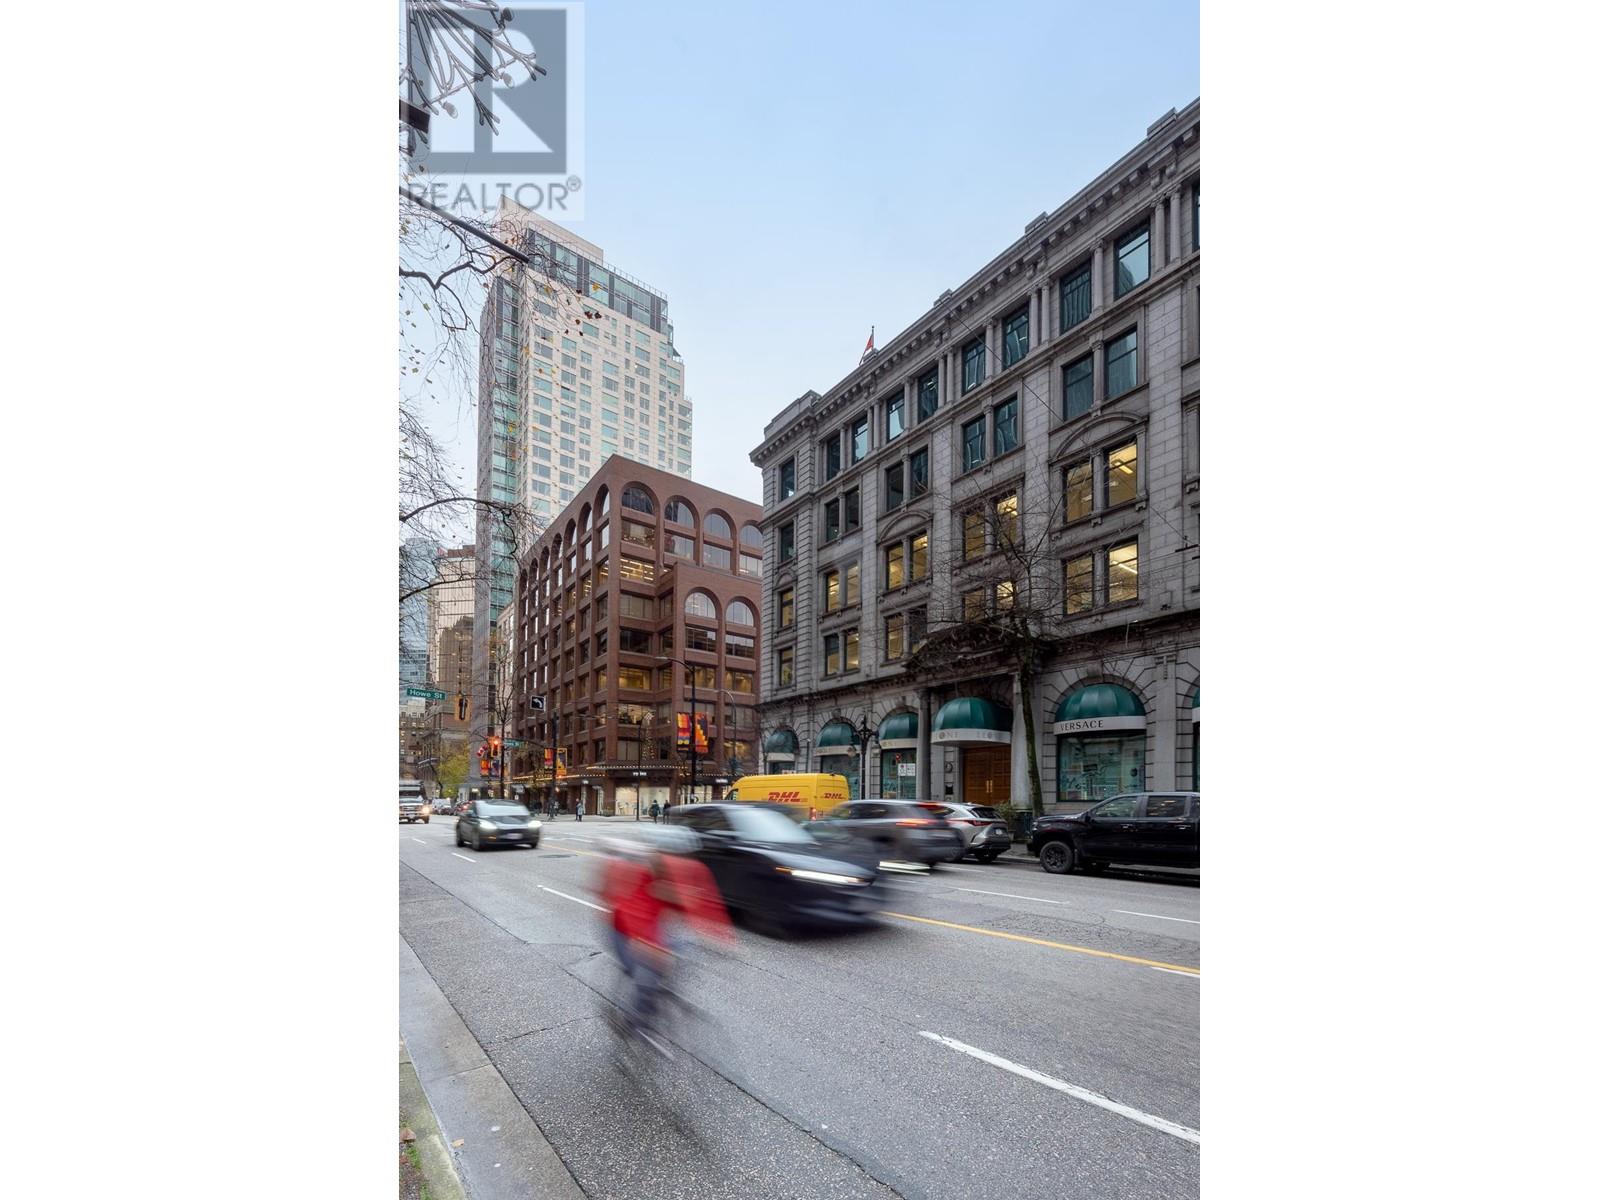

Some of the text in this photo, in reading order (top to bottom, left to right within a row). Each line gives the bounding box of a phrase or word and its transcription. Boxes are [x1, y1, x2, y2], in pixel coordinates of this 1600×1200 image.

[410, 689, 431, 698] Howe
[1060, 719, 1104, 732] VERSACE
[768, 791, 801, 803] DHL
[823, 792, 844, 800] DHL
